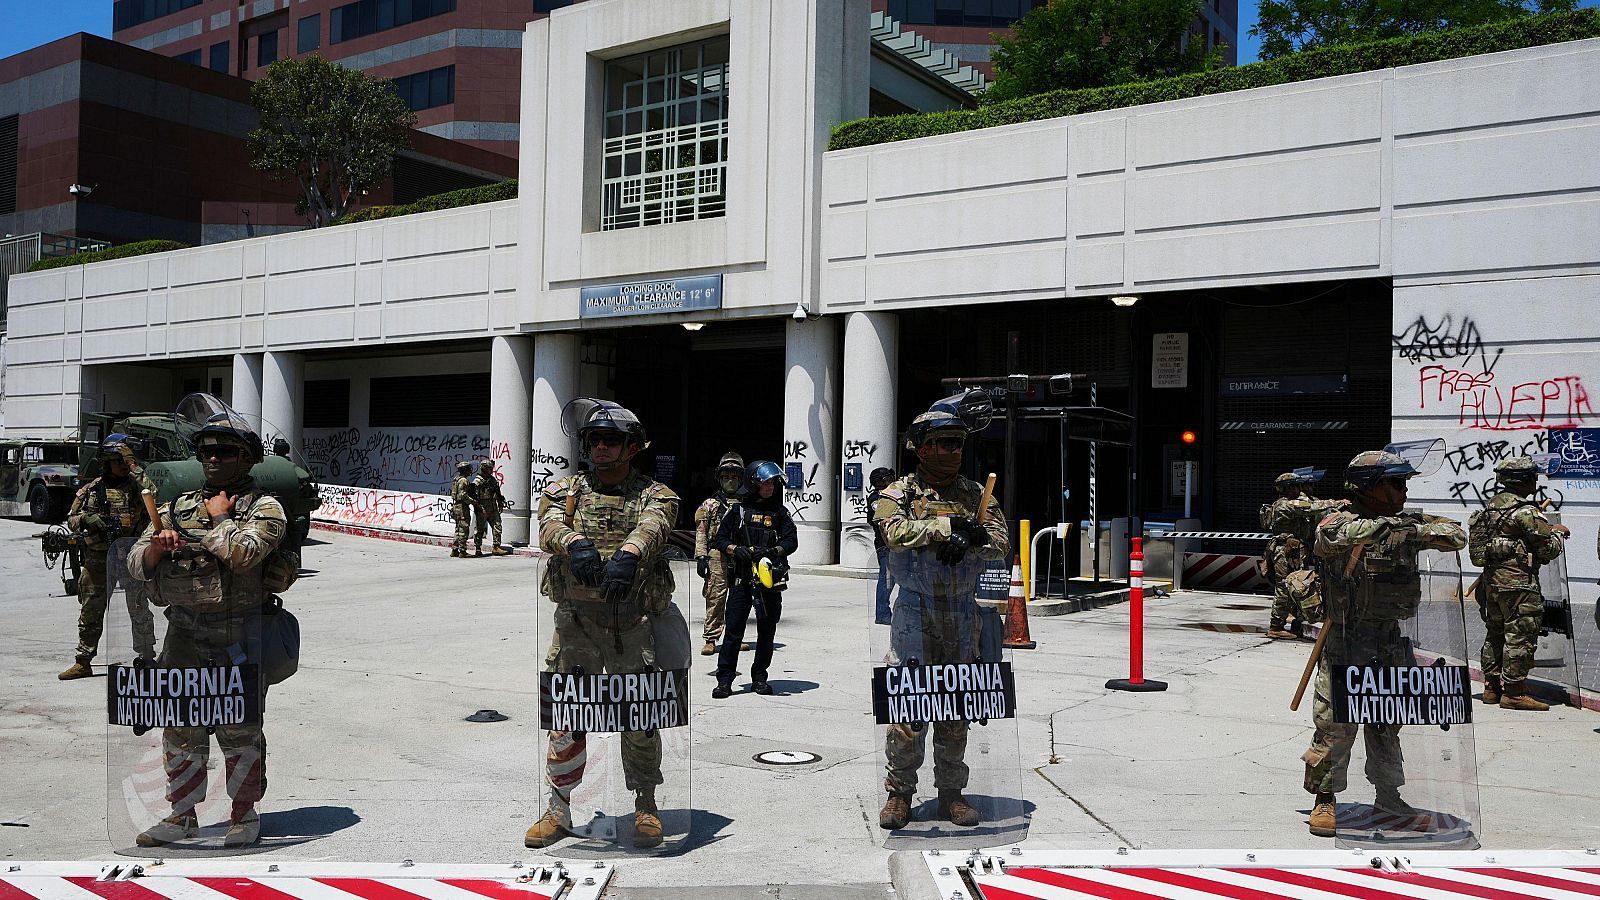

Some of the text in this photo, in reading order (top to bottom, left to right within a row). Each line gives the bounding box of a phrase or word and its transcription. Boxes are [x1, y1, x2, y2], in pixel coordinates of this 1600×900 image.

[587, 296, 630, 308] MAXIMUM
[633, 290, 686, 303] CLEARANCE
[620, 282, 676, 295] LOADING DOCK
[1228, 382, 1280, 391] ENTRANCE
[1250, 422, 1294, 430] CLEARANCE
[380, 434, 403, 456] ALL
[404, 434, 436, 453] COPS
[437, 433, 467, 451] ARE
[785, 440, 808, 459] OUR
[844, 440, 877, 463] CITY
[531, 475, 553, 497] ACA
[1566, 479, 1600, 489] KIDNA
[802, 493, 822, 504] COP
[116, 665, 244, 697] CALIFORNIA
[550, 671, 678, 703] CALIFORNIA
[886, 663, 1003, 695] CALIFORNIA
[1346, 665, 1463, 695] CALIFORNIA
[117, 696, 246, 728] NATIONAL GUARD
[552, 699, 678, 732] NATIONAL GUARD
[887, 691, 1005, 723] NATIONAL GUARD
[1348, 695, 1464, 725] NATIONAL GUARD
